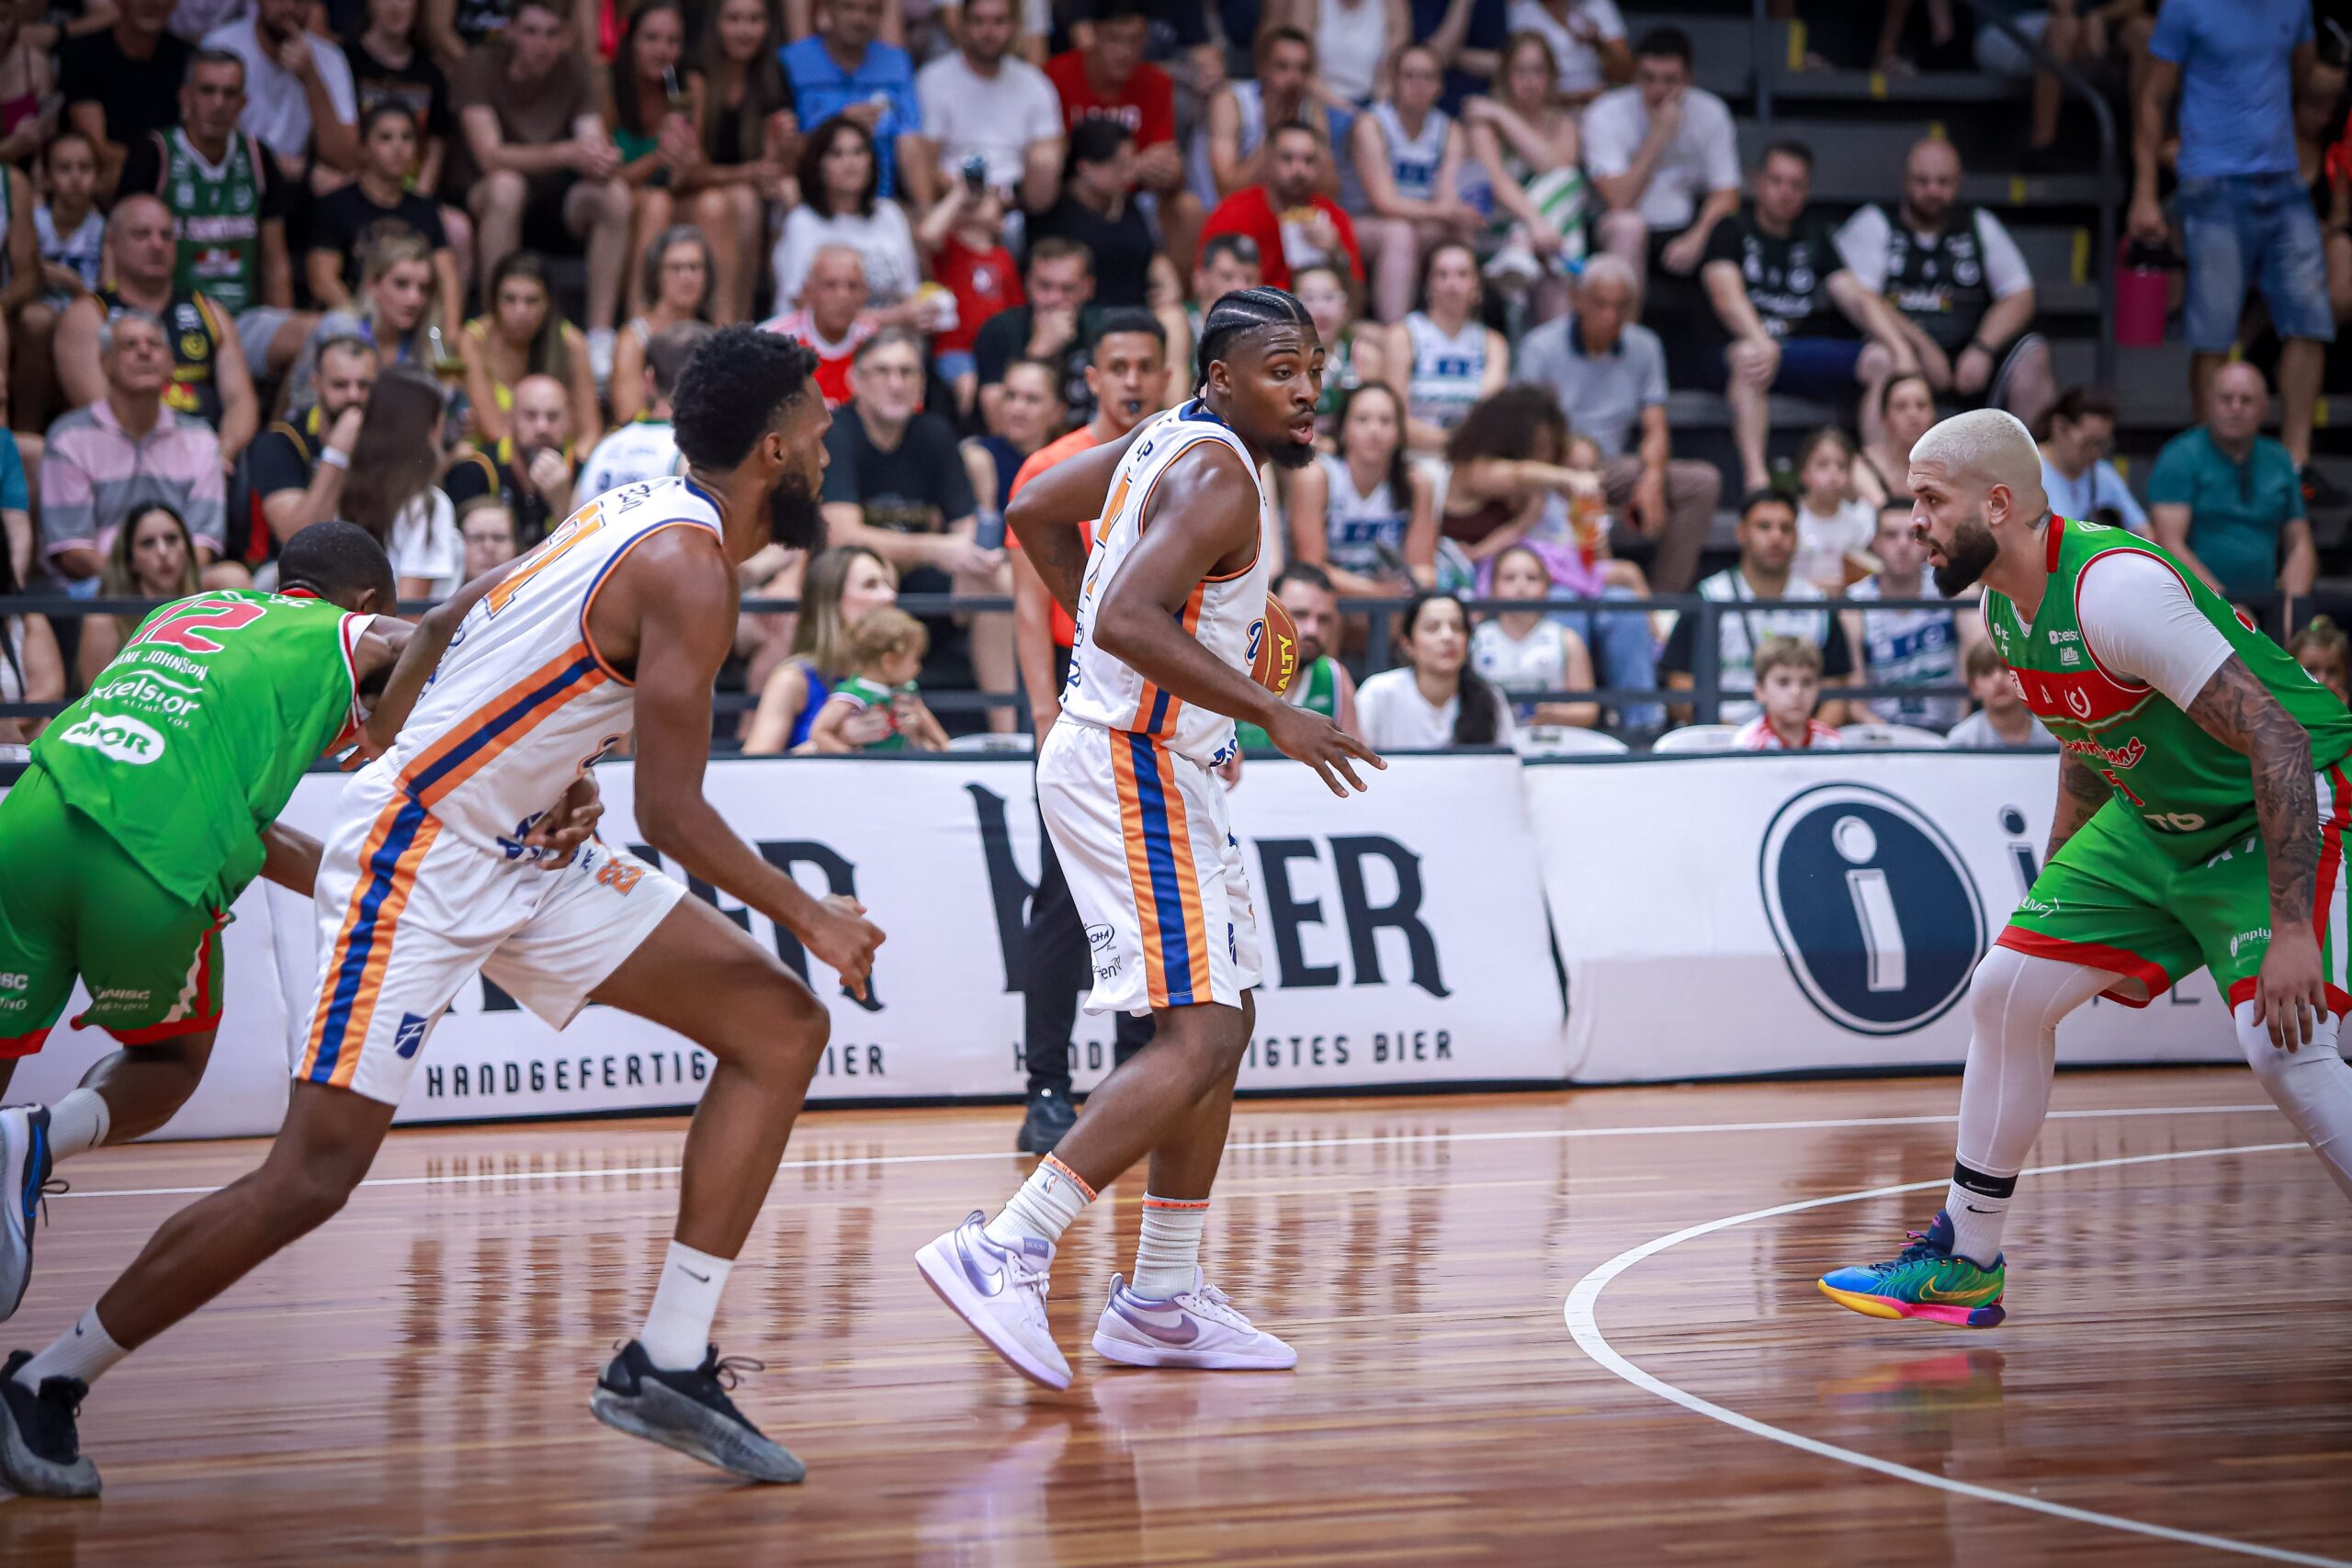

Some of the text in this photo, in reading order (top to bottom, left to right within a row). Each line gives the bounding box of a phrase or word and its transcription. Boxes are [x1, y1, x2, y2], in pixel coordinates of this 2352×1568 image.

[141, 649, 209, 682] JOHNSON
[121, 698, 190, 729] ALIMETOS
[1089, 929, 1110, 944] CHA
[1374, 1028, 1453, 1063] BIER
[426, 1043, 887, 1098] HANDGEFERTIG IER
